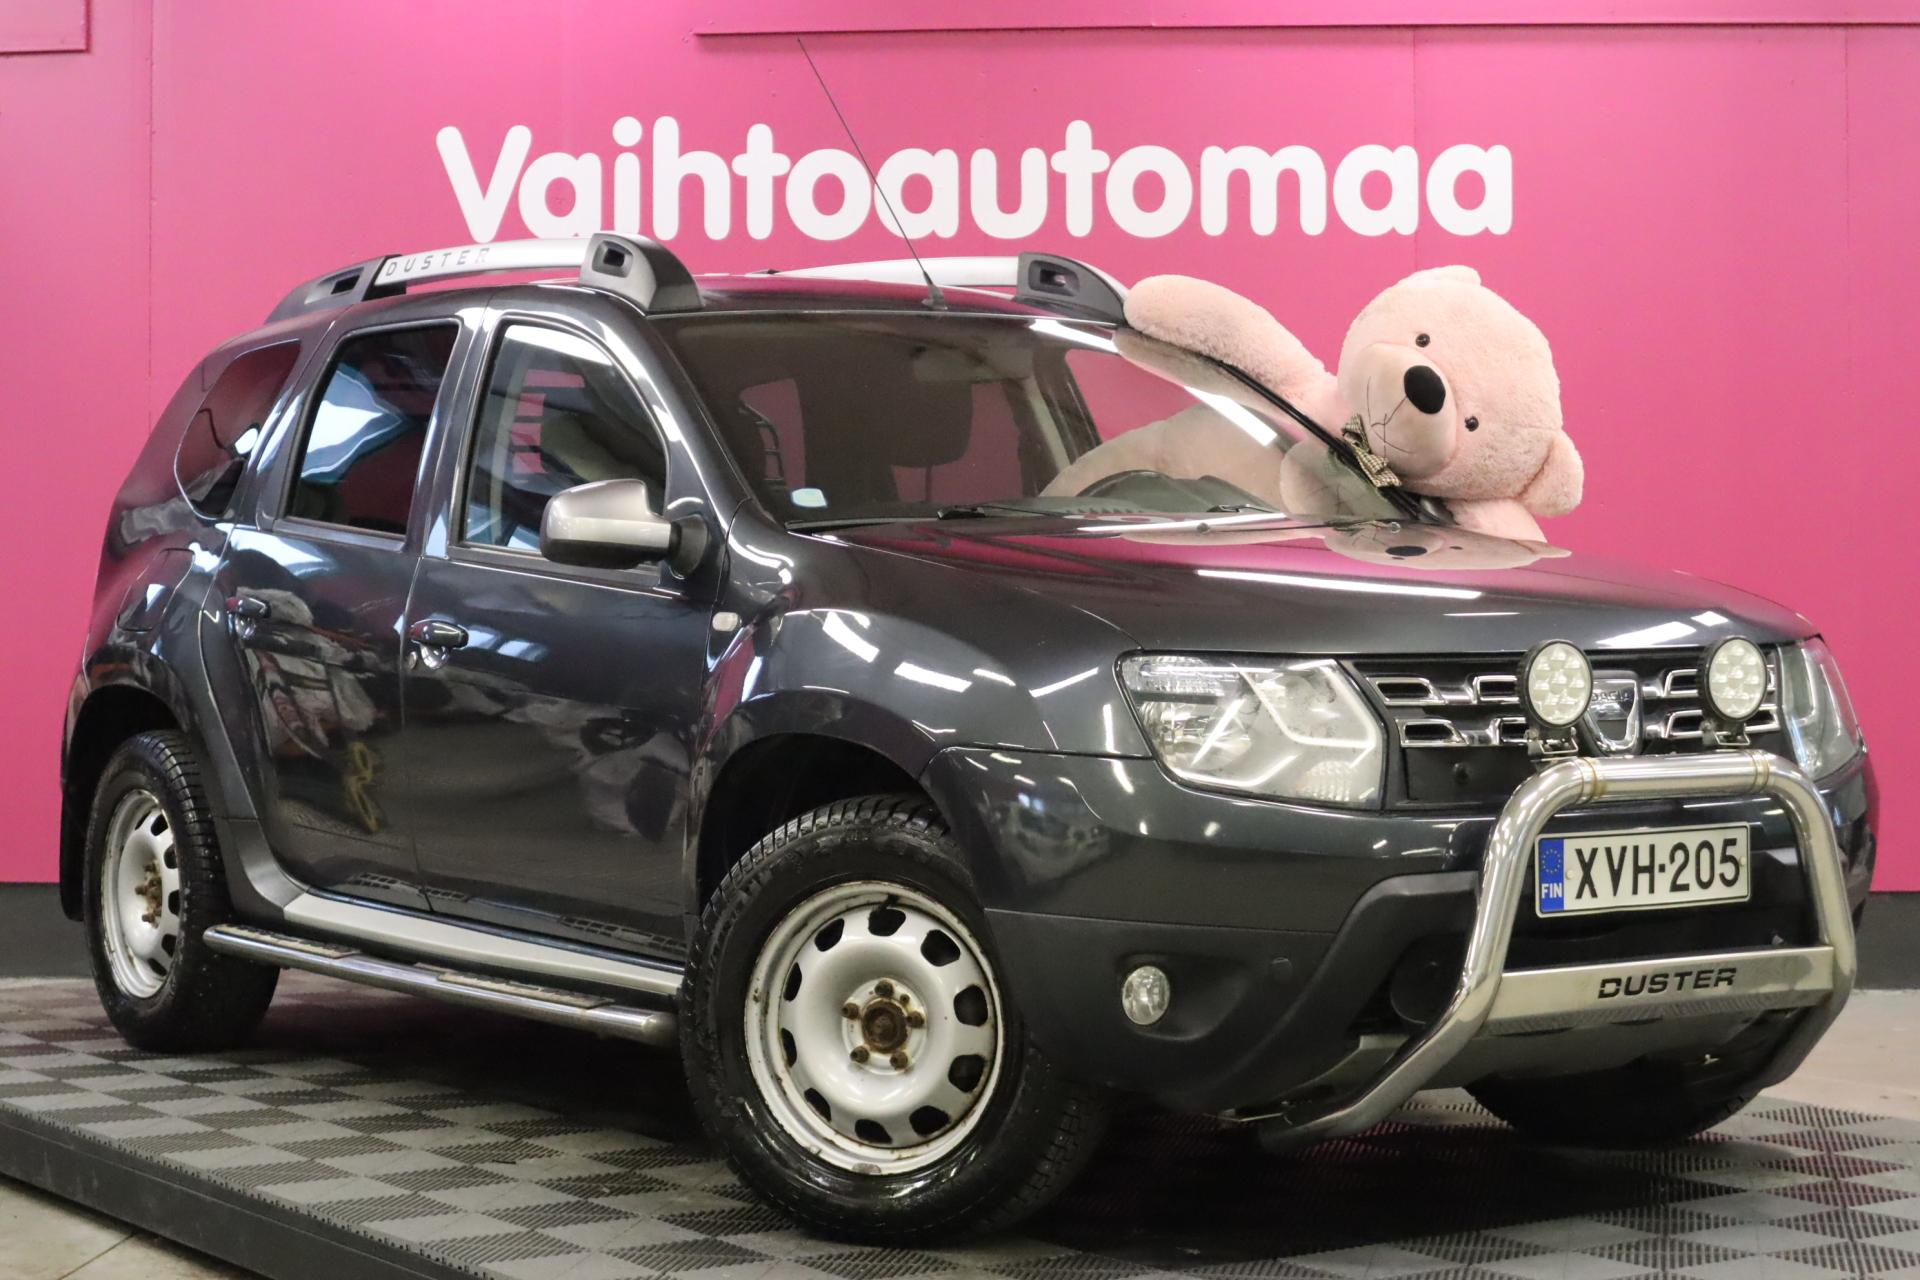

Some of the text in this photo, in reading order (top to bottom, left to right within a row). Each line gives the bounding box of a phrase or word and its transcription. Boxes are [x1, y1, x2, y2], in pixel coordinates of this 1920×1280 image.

[437, 116, 1514, 242] Vaihtoautomaa
[385, 248, 490, 277] DUSTER
[1541, 882, 1563, 899] FIN
[1597, 967, 1738, 999] DUSTER
